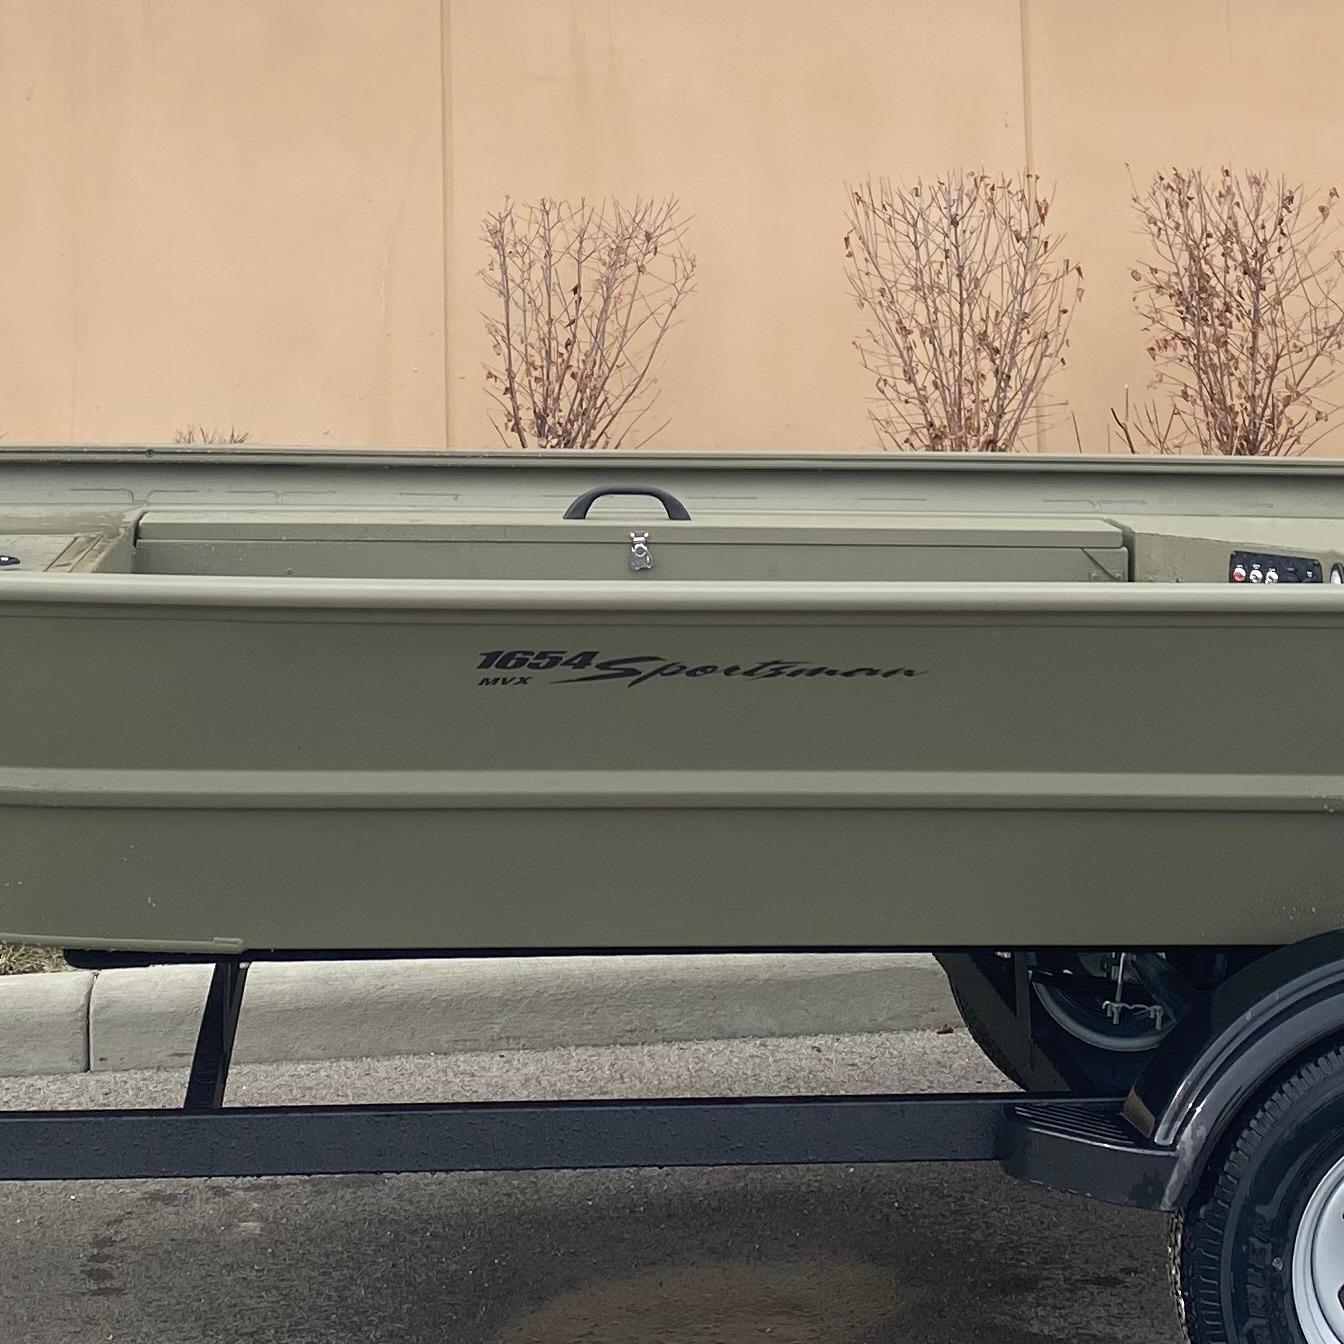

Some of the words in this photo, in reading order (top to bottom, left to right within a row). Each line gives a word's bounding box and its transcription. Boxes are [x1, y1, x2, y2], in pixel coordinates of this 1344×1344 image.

[477, 650, 599, 671] 1654
[550, 654, 930, 689] Sportsman
[477, 675, 534, 687] MVX
